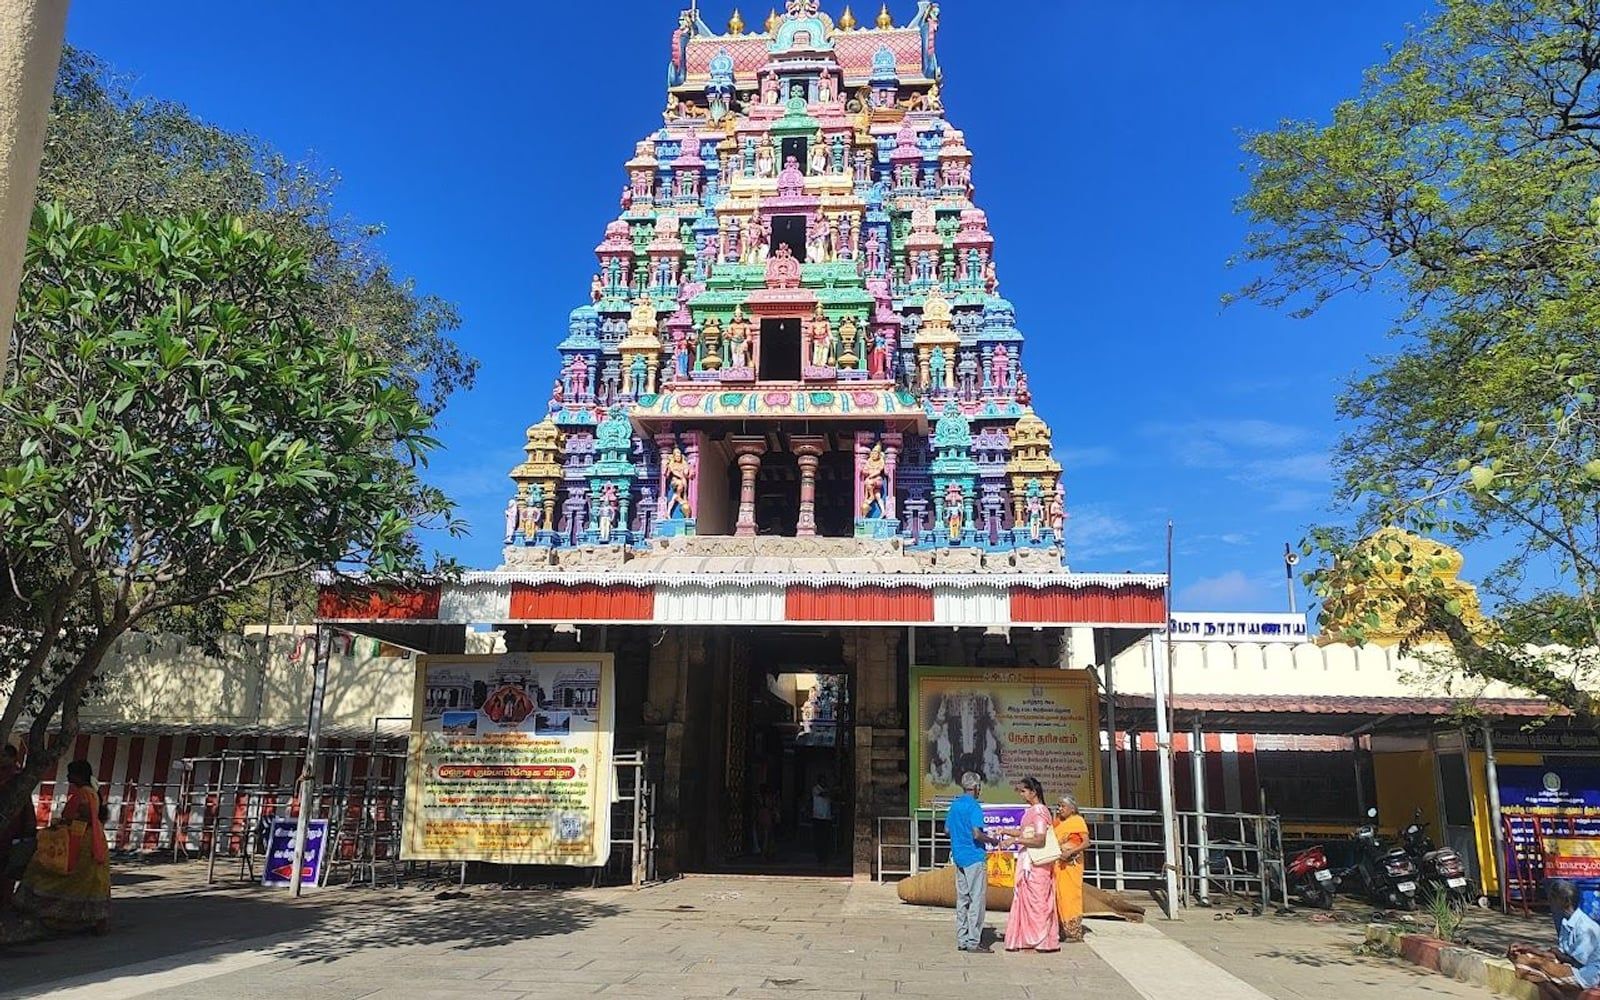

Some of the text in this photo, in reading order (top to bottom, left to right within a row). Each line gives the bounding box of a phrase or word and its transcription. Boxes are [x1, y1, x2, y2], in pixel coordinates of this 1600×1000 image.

[1170, 618, 1306, 636] மோ நாராயணாய
[1037, 733, 1078, 745] தரிசனம்
[544, 767, 571, 780] விழா
